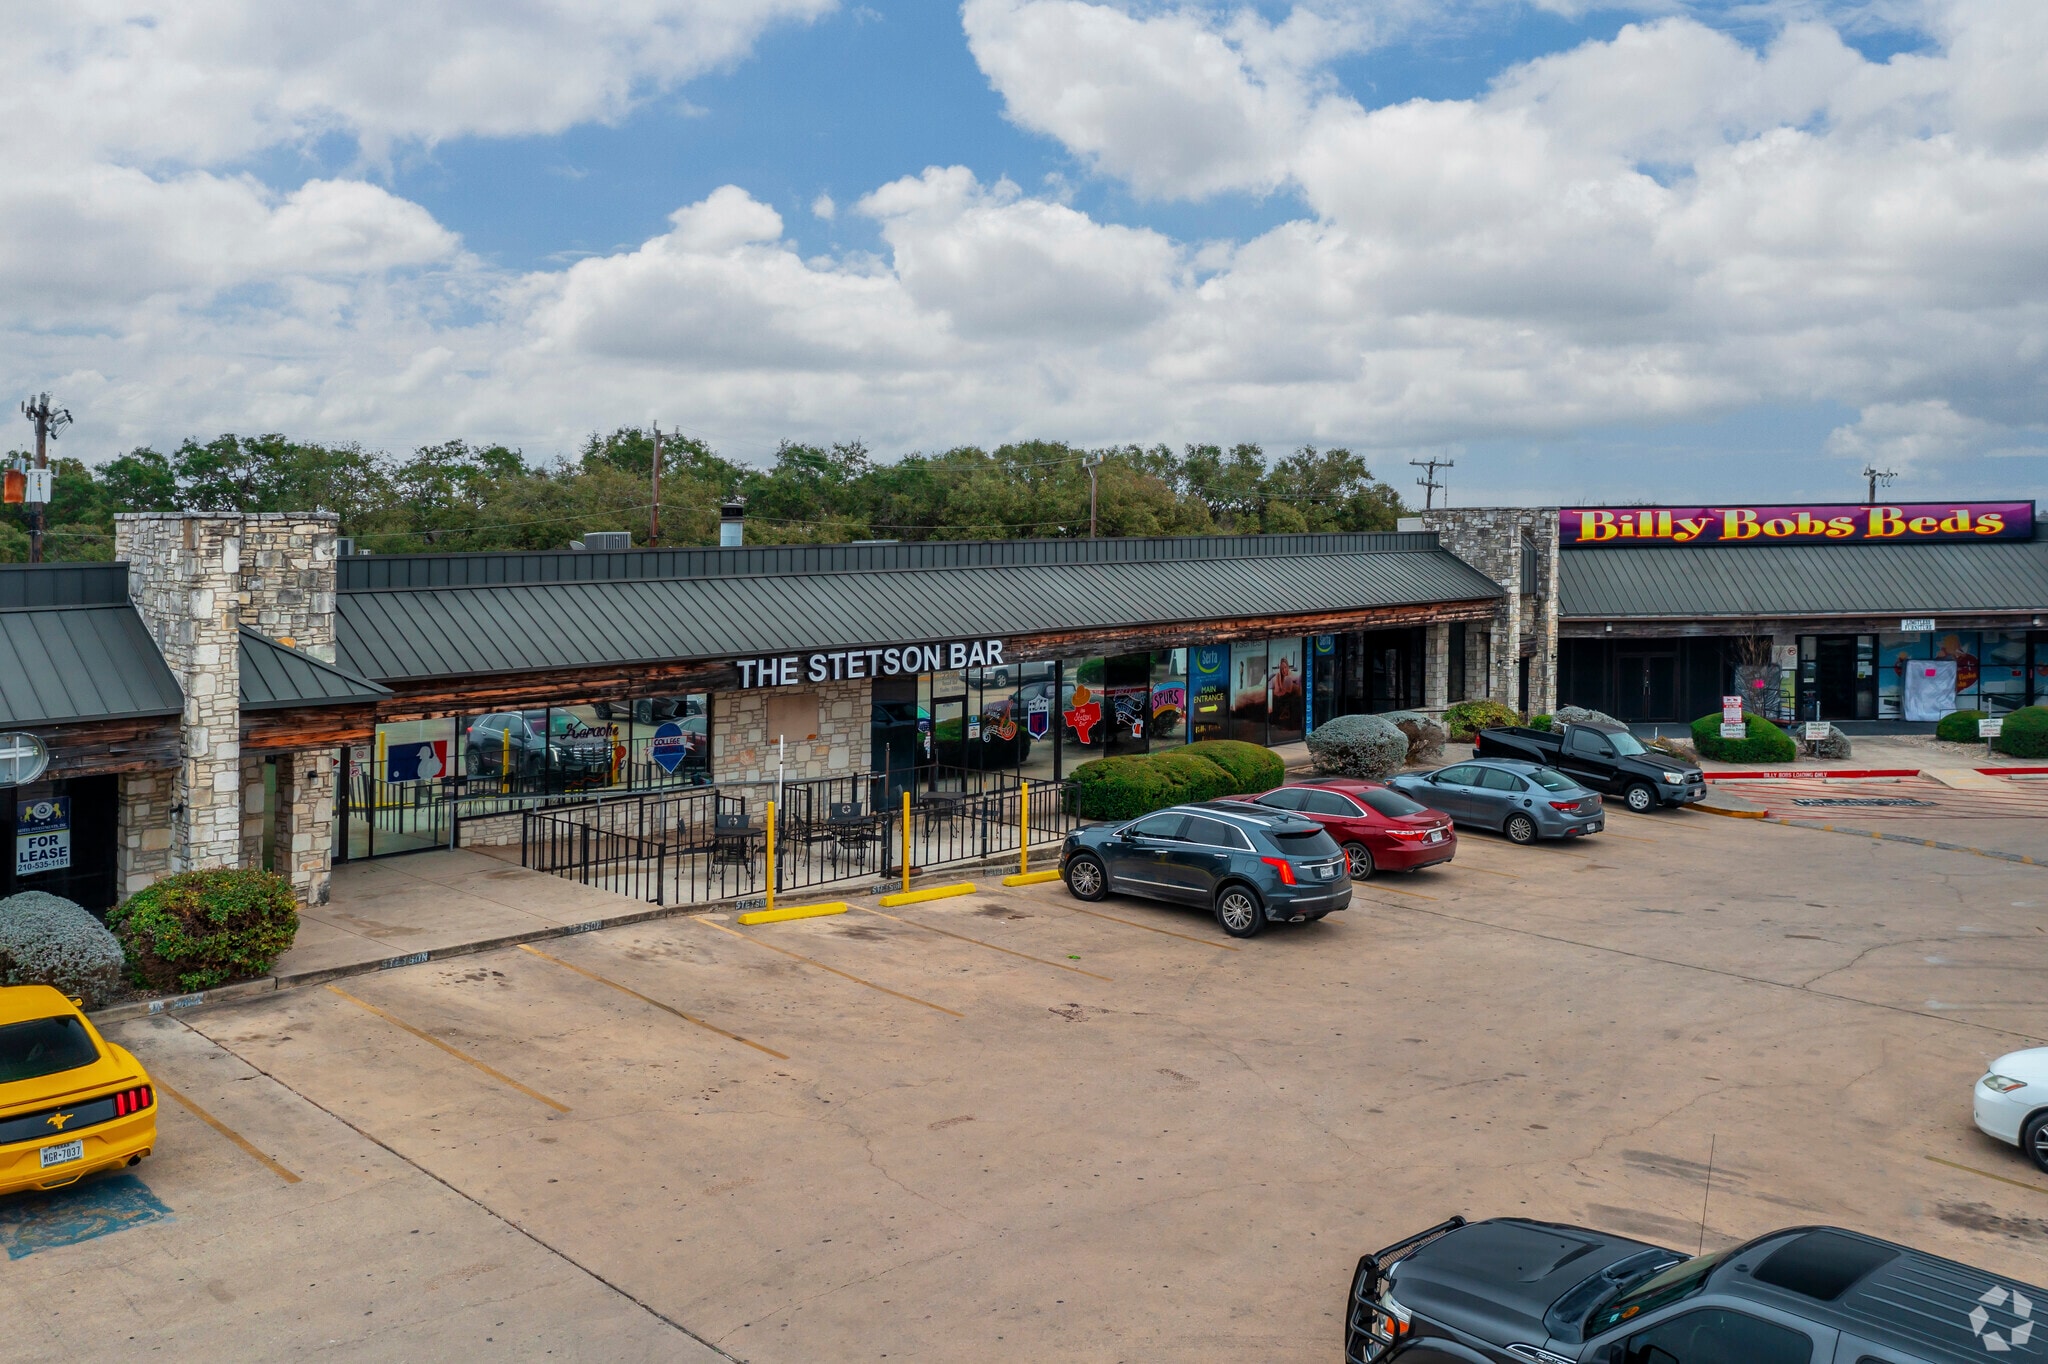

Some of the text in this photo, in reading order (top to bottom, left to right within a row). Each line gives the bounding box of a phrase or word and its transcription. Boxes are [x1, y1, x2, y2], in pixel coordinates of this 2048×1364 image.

[1572, 506, 2005, 542] Billy Bobs Beds
[737, 657, 798, 689] THE
[808, 645, 941, 682] STETSON
[949, 640, 1004, 669] BAR
[1202, 650, 1218, 664] Serta
[1201, 685, 1217, 694] MAIN
[1154, 689, 1179, 709] SPURS
[1193, 692, 1225, 703] ENTRANCE
[559, 720, 620, 740] Karaoke
[653, 737, 681, 746] COLLEGE
[28, 835, 58, 848] FOR
[20, 846, 67, 863] LEASE
